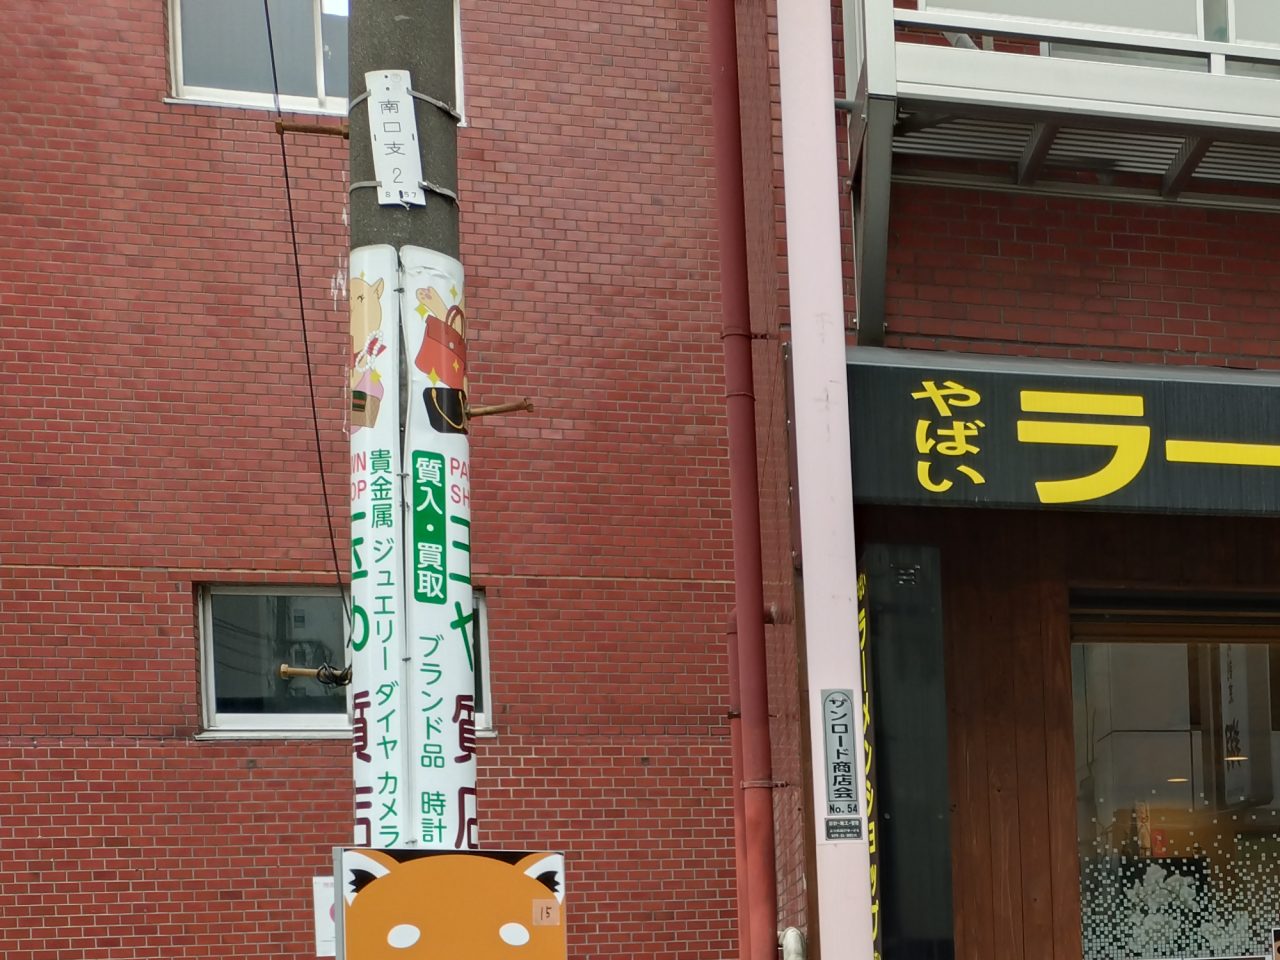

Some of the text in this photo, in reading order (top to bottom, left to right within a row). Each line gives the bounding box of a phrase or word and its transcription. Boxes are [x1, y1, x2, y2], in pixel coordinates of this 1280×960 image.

[910, 380, 987, 493] やばい
[369, 447, 400, 849] 貴金属 ジュエリー ダイヤ カメラ
[418, 633, 448, 844] ブランド品 時計
[847, 803, 858, 814] 54
